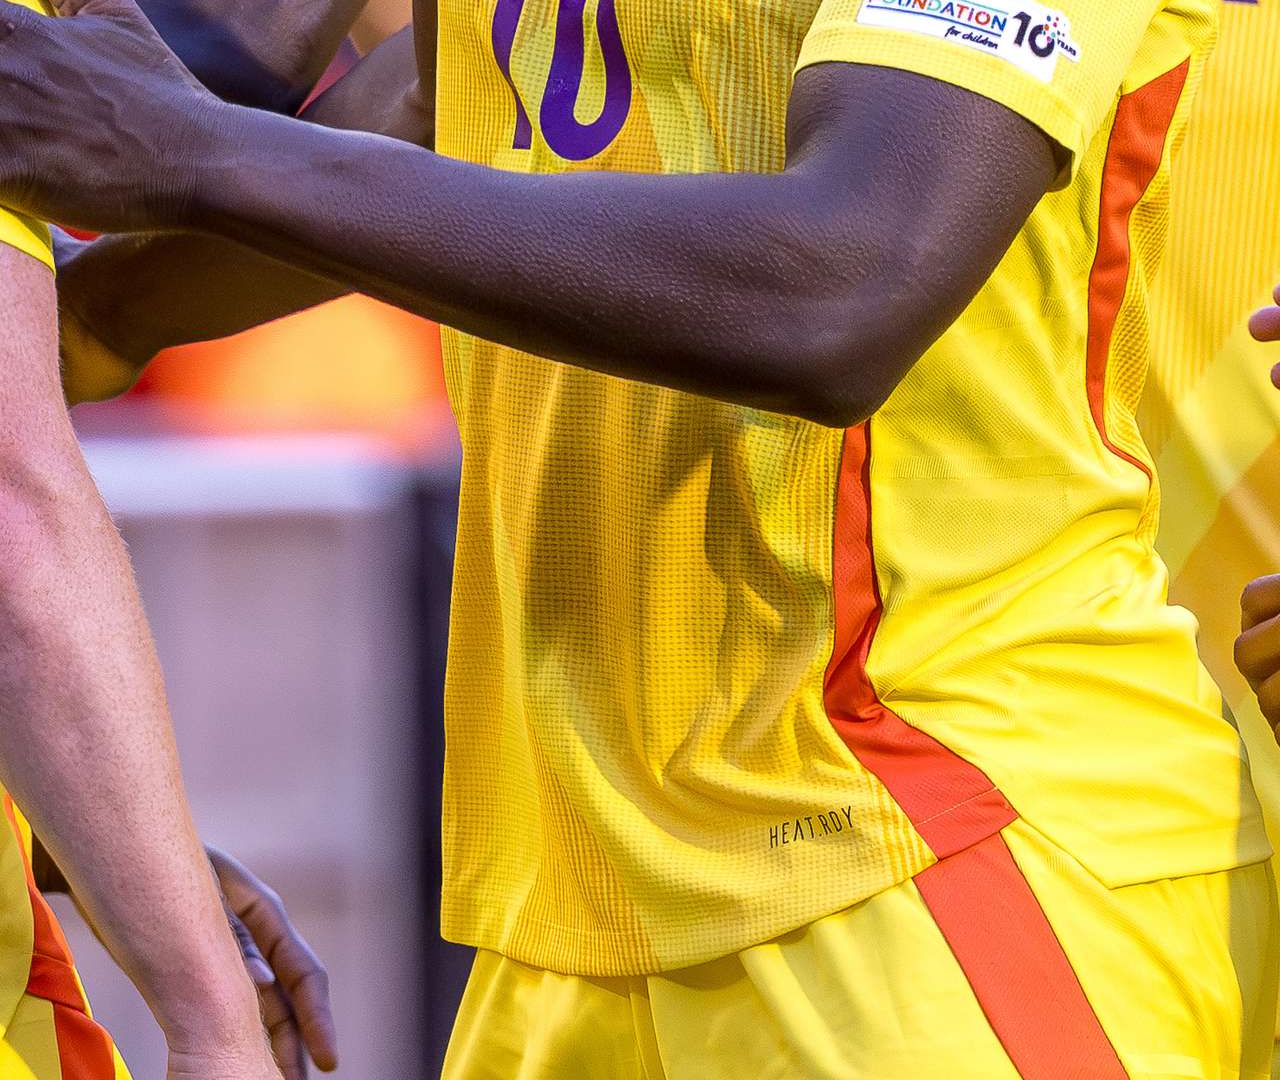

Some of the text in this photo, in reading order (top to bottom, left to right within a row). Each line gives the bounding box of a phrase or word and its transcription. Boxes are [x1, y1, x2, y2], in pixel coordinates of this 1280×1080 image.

[945, 25, 999, 50] for children
[1013, 11, 1056, 58] 10
[769, 805, 854, 848] HEAT.RDY
